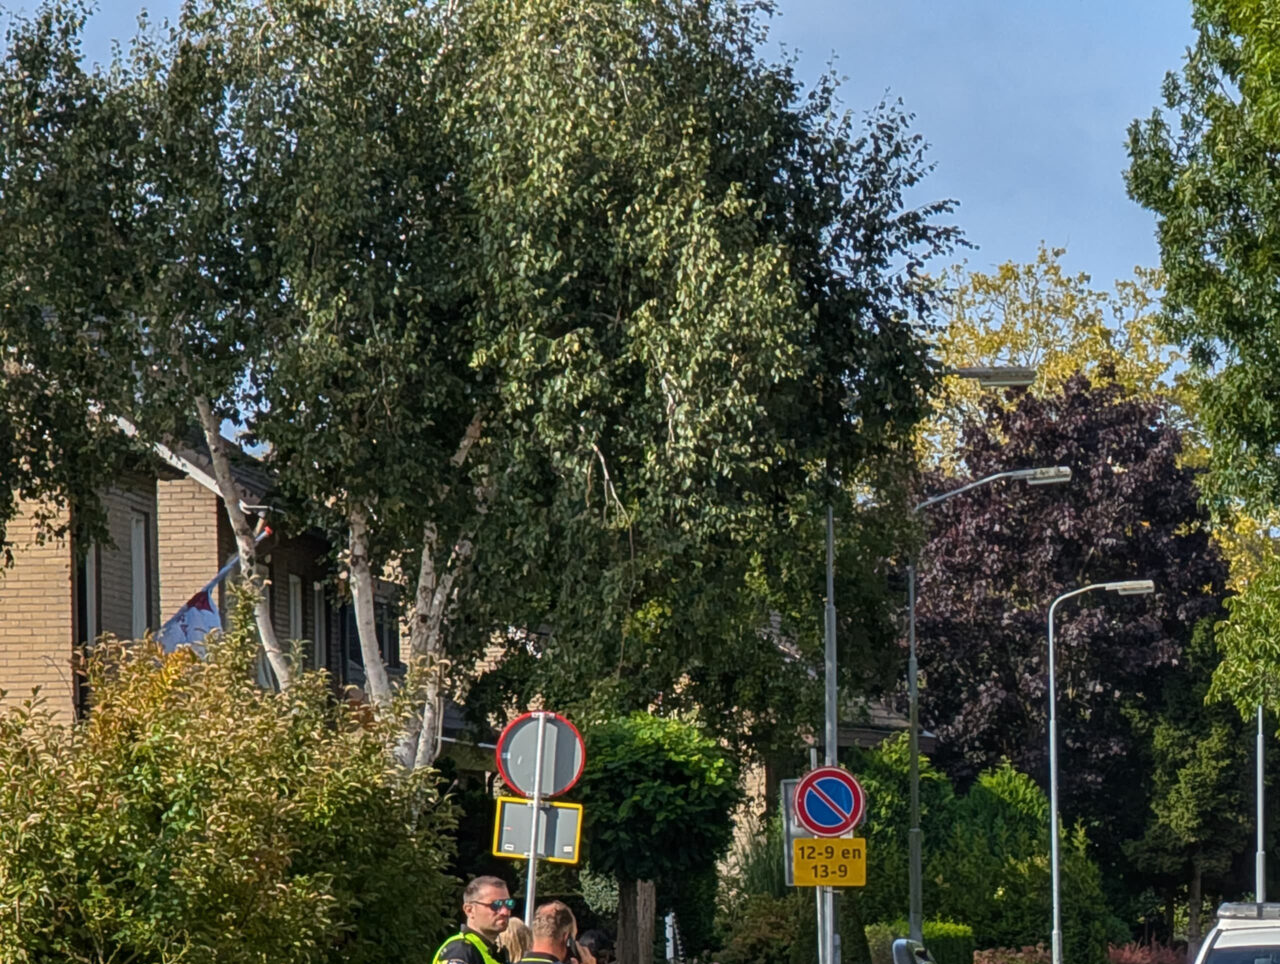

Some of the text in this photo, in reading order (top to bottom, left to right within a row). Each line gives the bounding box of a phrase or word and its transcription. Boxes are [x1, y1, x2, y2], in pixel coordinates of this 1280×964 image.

[798, 846, 862, 860] 12-9 en
[811, 864, 848, 878] 13-9
